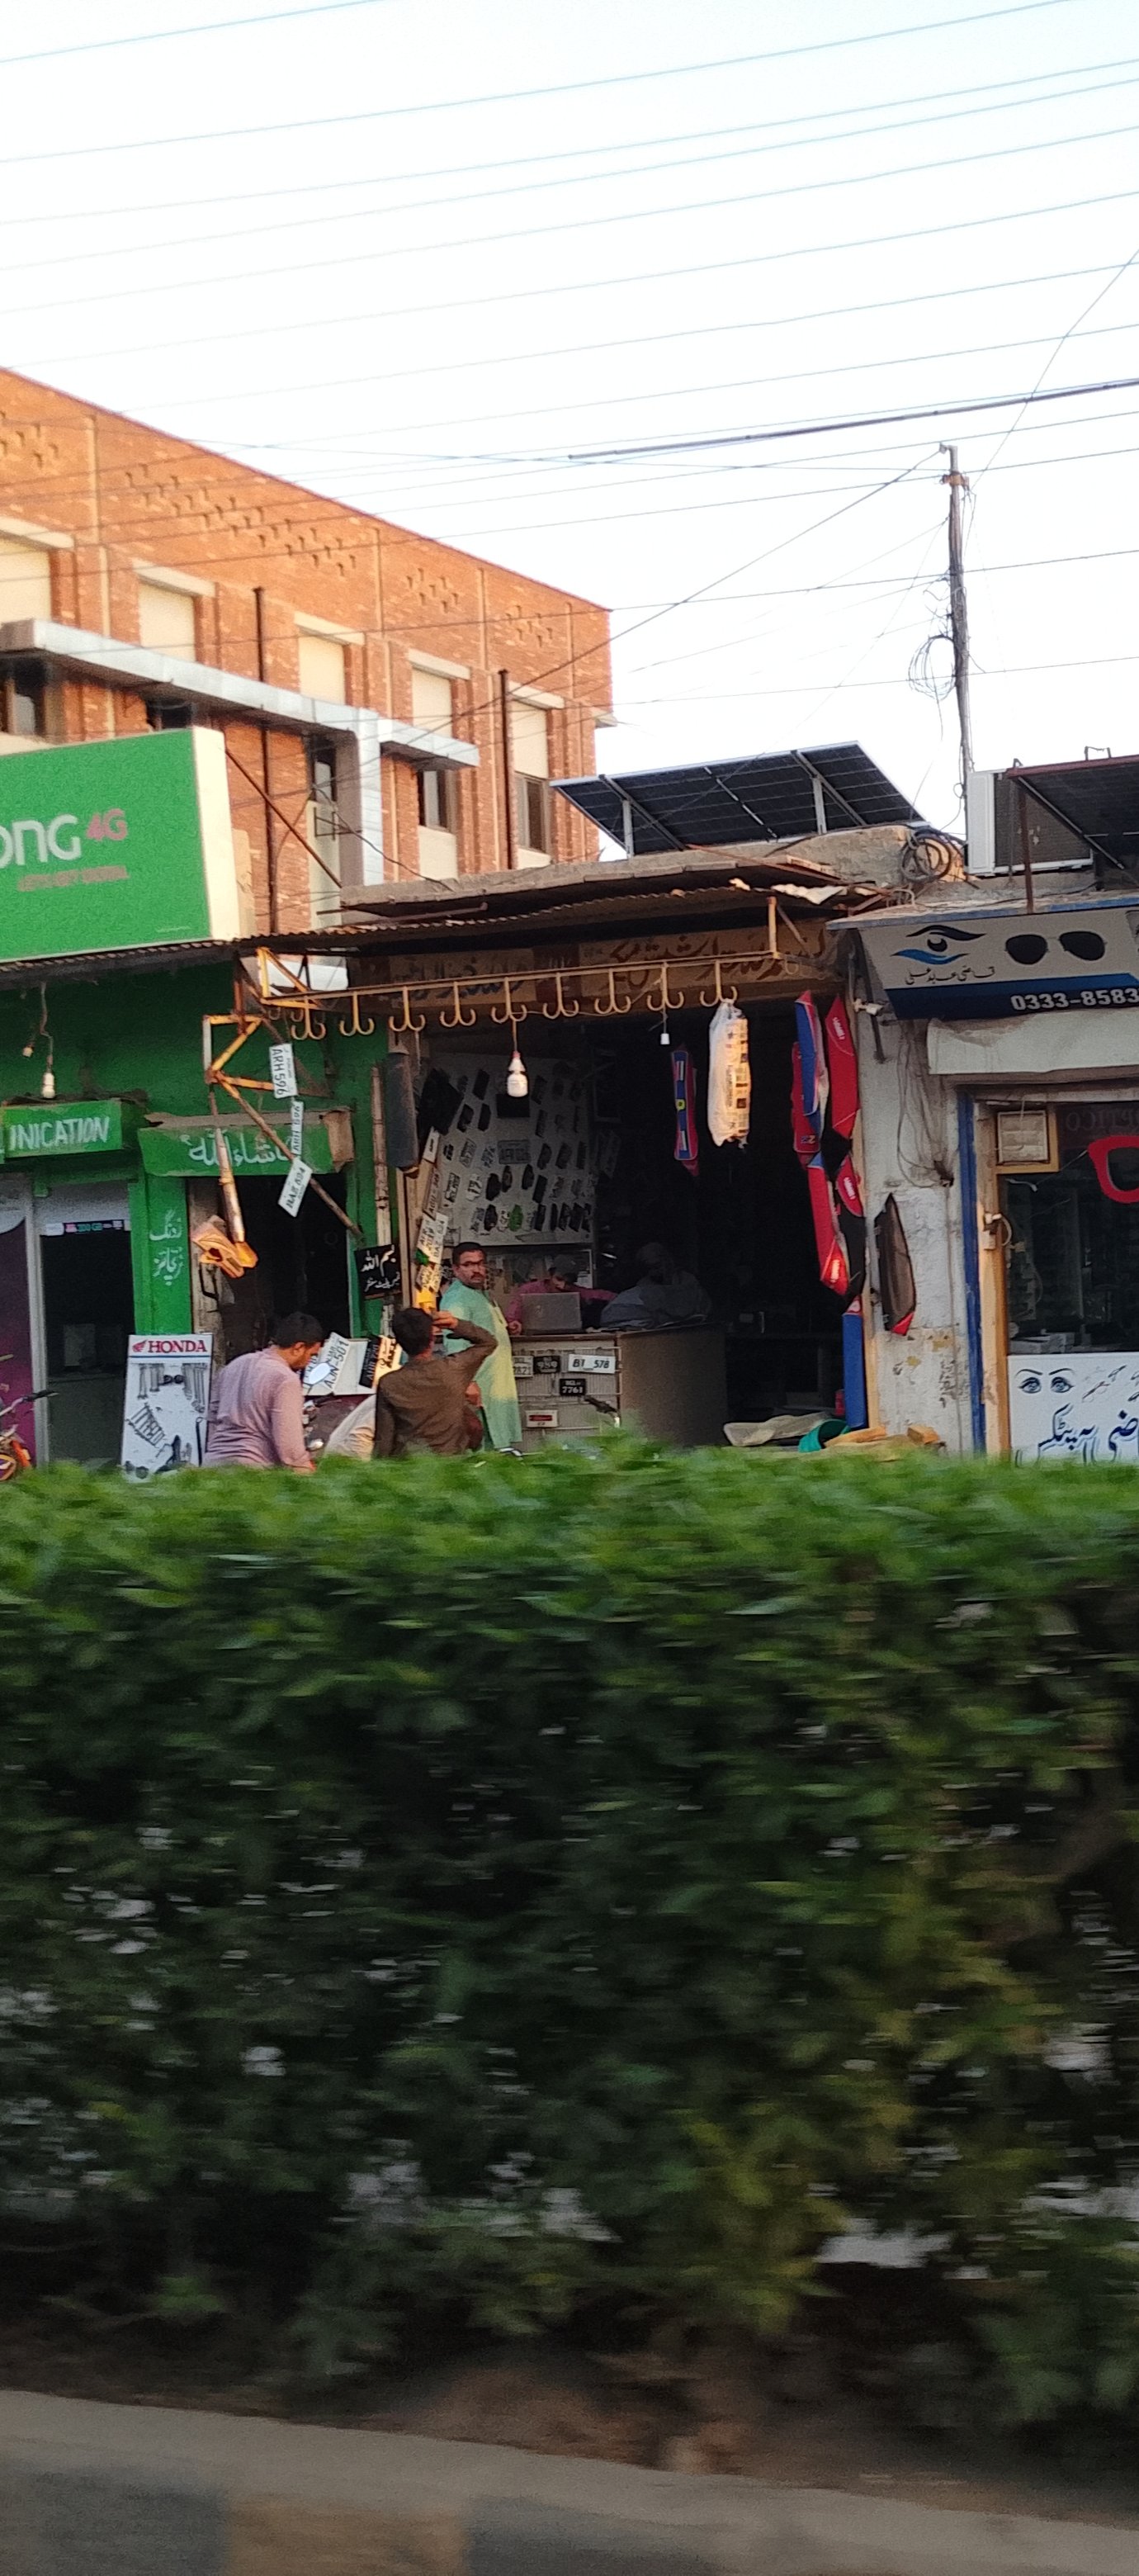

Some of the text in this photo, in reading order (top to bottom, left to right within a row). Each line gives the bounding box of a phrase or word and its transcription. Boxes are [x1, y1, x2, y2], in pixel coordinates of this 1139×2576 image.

[86, 808, 128, 841] 4G
[1010, 987, 1139, 1011] 0333-8583
[271, 1048, 288, 1095] ARH 596
[148, 1339, 207, 1353] HONDA
